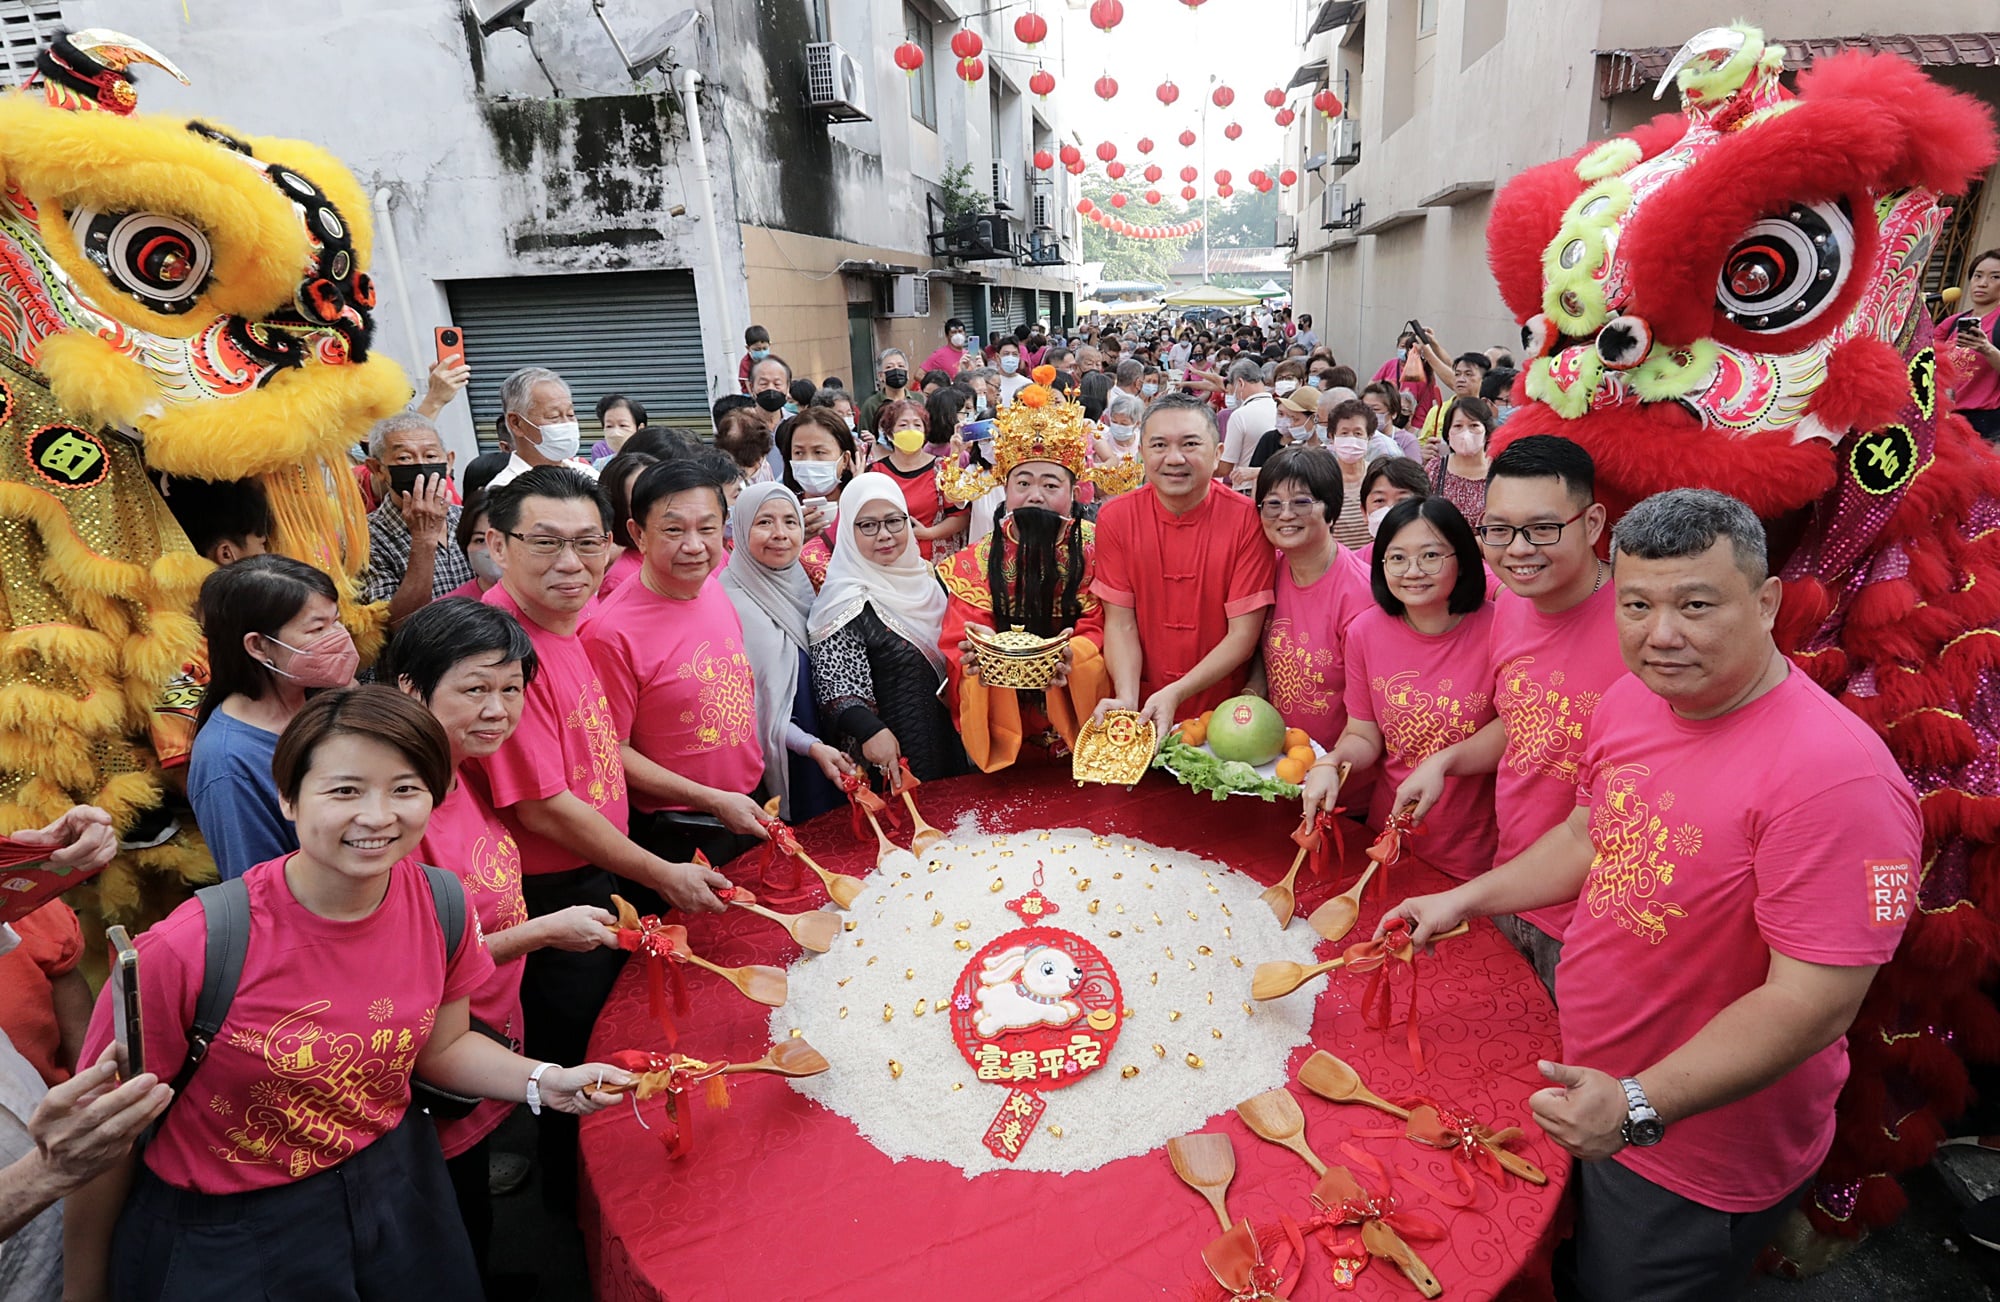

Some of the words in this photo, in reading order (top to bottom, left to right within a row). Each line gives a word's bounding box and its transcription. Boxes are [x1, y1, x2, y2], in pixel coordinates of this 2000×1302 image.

[1874, 872, 1909, 888] KIN
[1875, 887, 1908, 905] RA
[1021, 897, 1044, 916] 福
[1876, 904, 1906, 922] RA
[371, 1028, 415, 1055] 卯兔
[974, 1034, 1102, 1082] 富貴平安
[995, 1092, 1033, 1154] 如意
